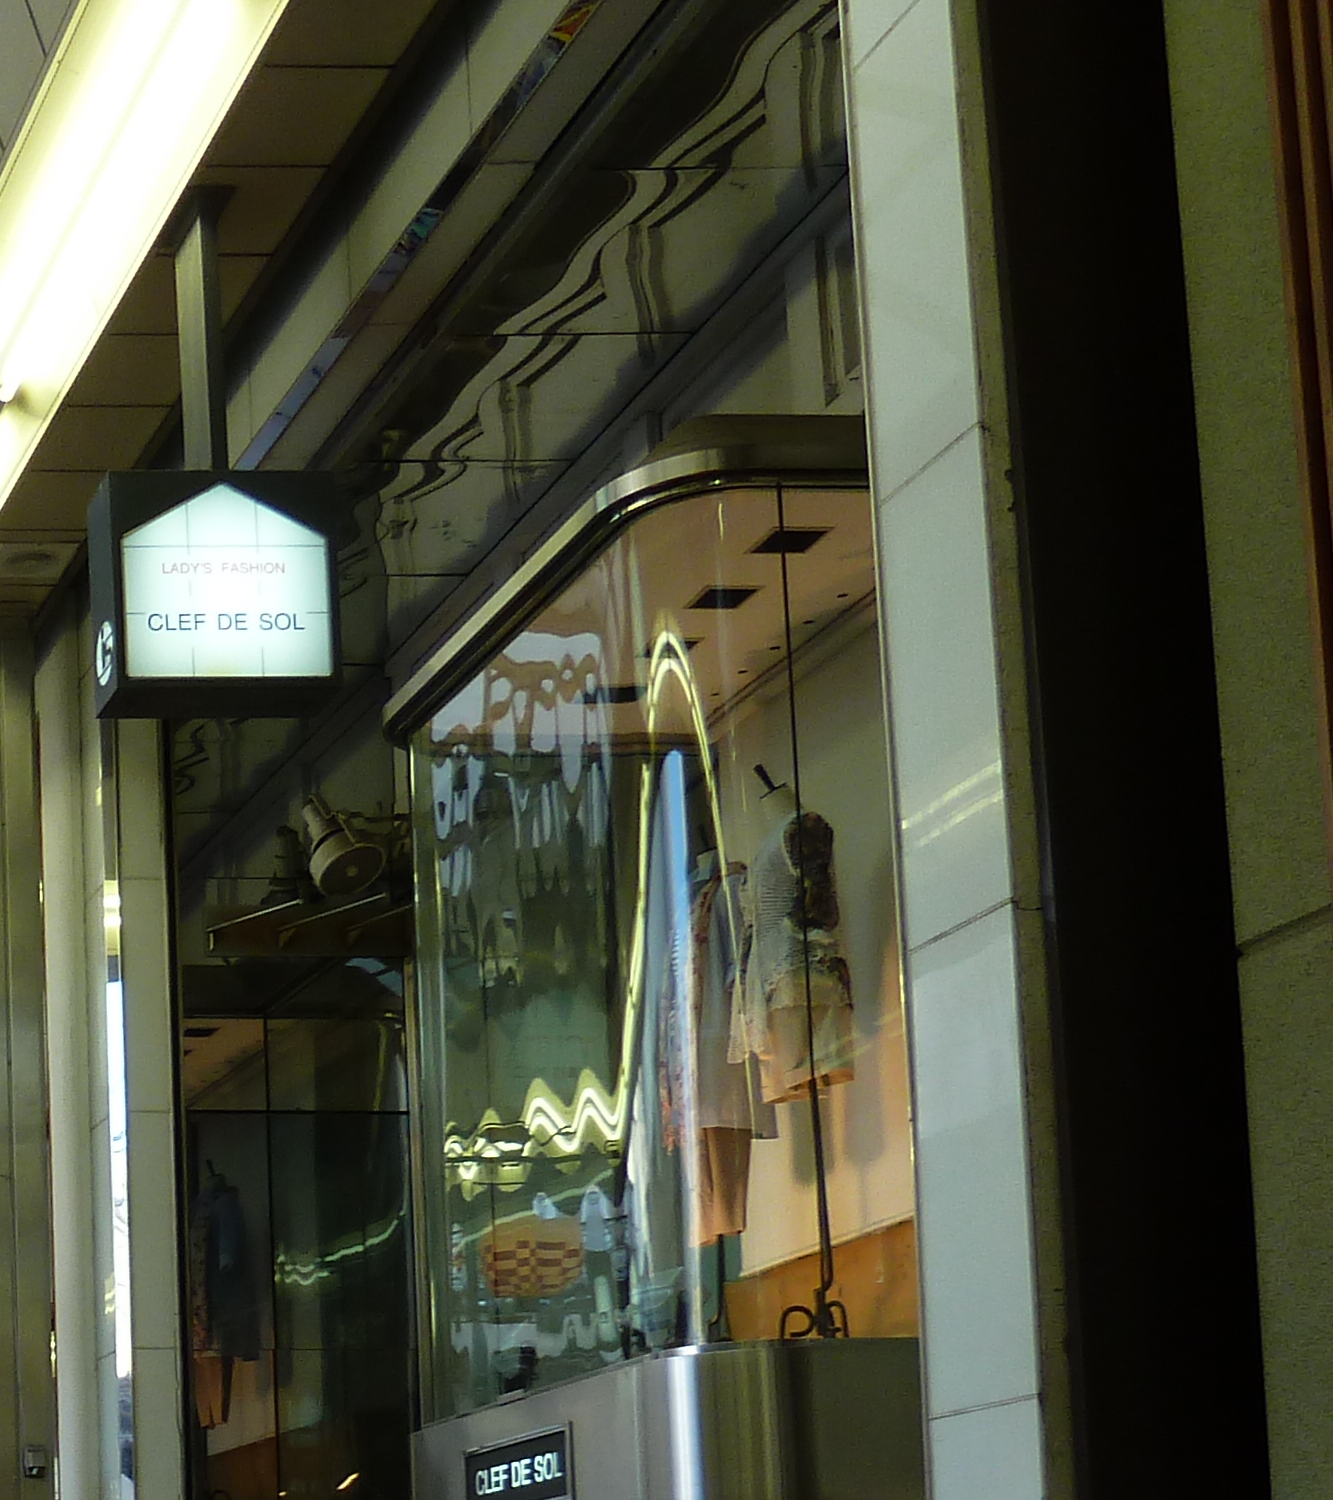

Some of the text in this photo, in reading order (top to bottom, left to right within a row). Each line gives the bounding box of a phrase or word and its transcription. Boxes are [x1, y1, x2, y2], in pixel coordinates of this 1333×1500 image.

[161, 562, 286, 574] LADY'S FASHION
[147, 612, 306, 631] CLEF DE SOL
[475, 1452, 564, 1496] CLEF DE SOL
